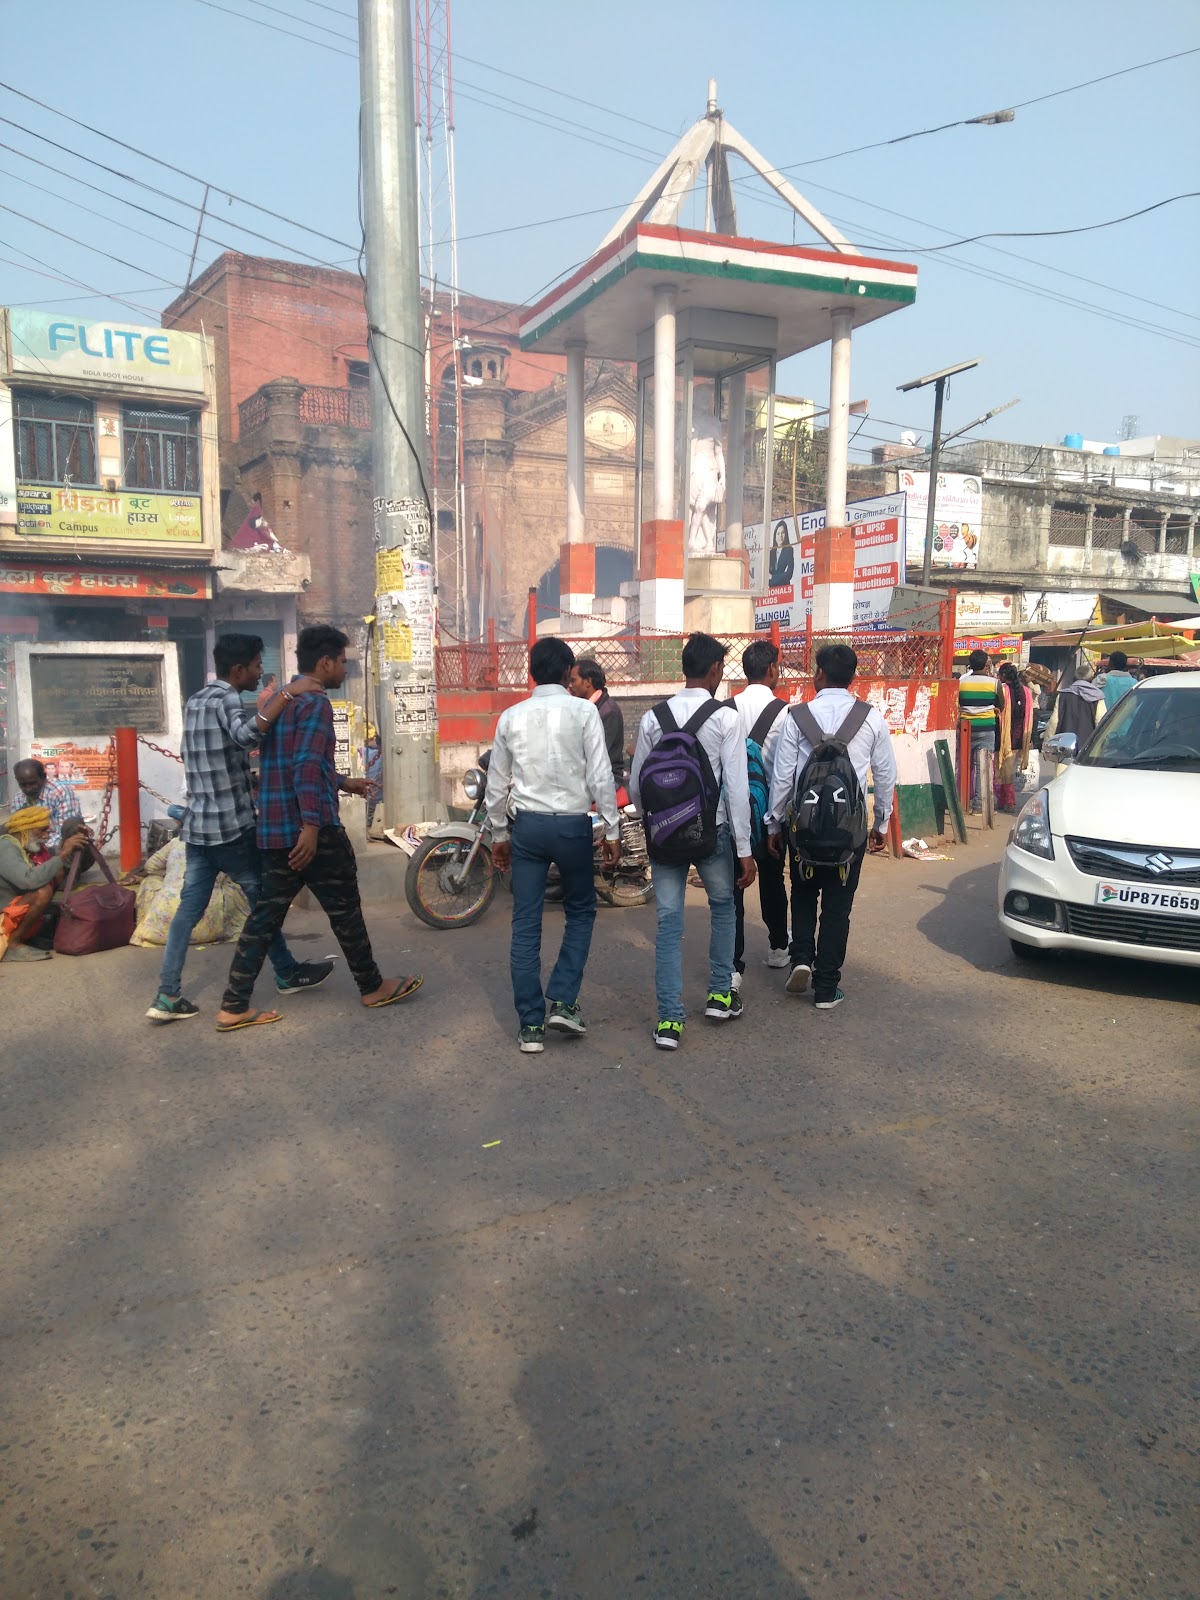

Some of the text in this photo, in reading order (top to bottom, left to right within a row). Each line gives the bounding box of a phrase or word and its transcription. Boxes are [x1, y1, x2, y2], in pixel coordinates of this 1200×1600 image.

[48, 322, 170, 366] FLITE
[82, 369, 145, 382] BIDLA BOOT HOUSE
[0, 494, 9, 505] de
[128, 497, 152, 511] बूट
[127, 511, 159, 526] हाउस
[854, 508, 886, 520] Grammar
[888, 505, 898, 513] for
[58, 521, 99, 533] Campus
[165, 527, 201, 538] NICHOLAS
[867, 522, 885, 533] UPSC
[855, 533, 894, 547] mpetitions
[862, 564, 892, 577] Railway
[42, 571, 76, 594] बूट
[79, 573, 140, 589] हाउस
[854, 577, 895, 590] mpetitions
[768, 587, 792, 596] IONALS
[763, 597, 778, 605] KIDS
[755, 609, 790, 622] B-LINGUA
[958, 602, 980, 616] इण्डेन
[1119, 889, 1200, 910] UP87E659
